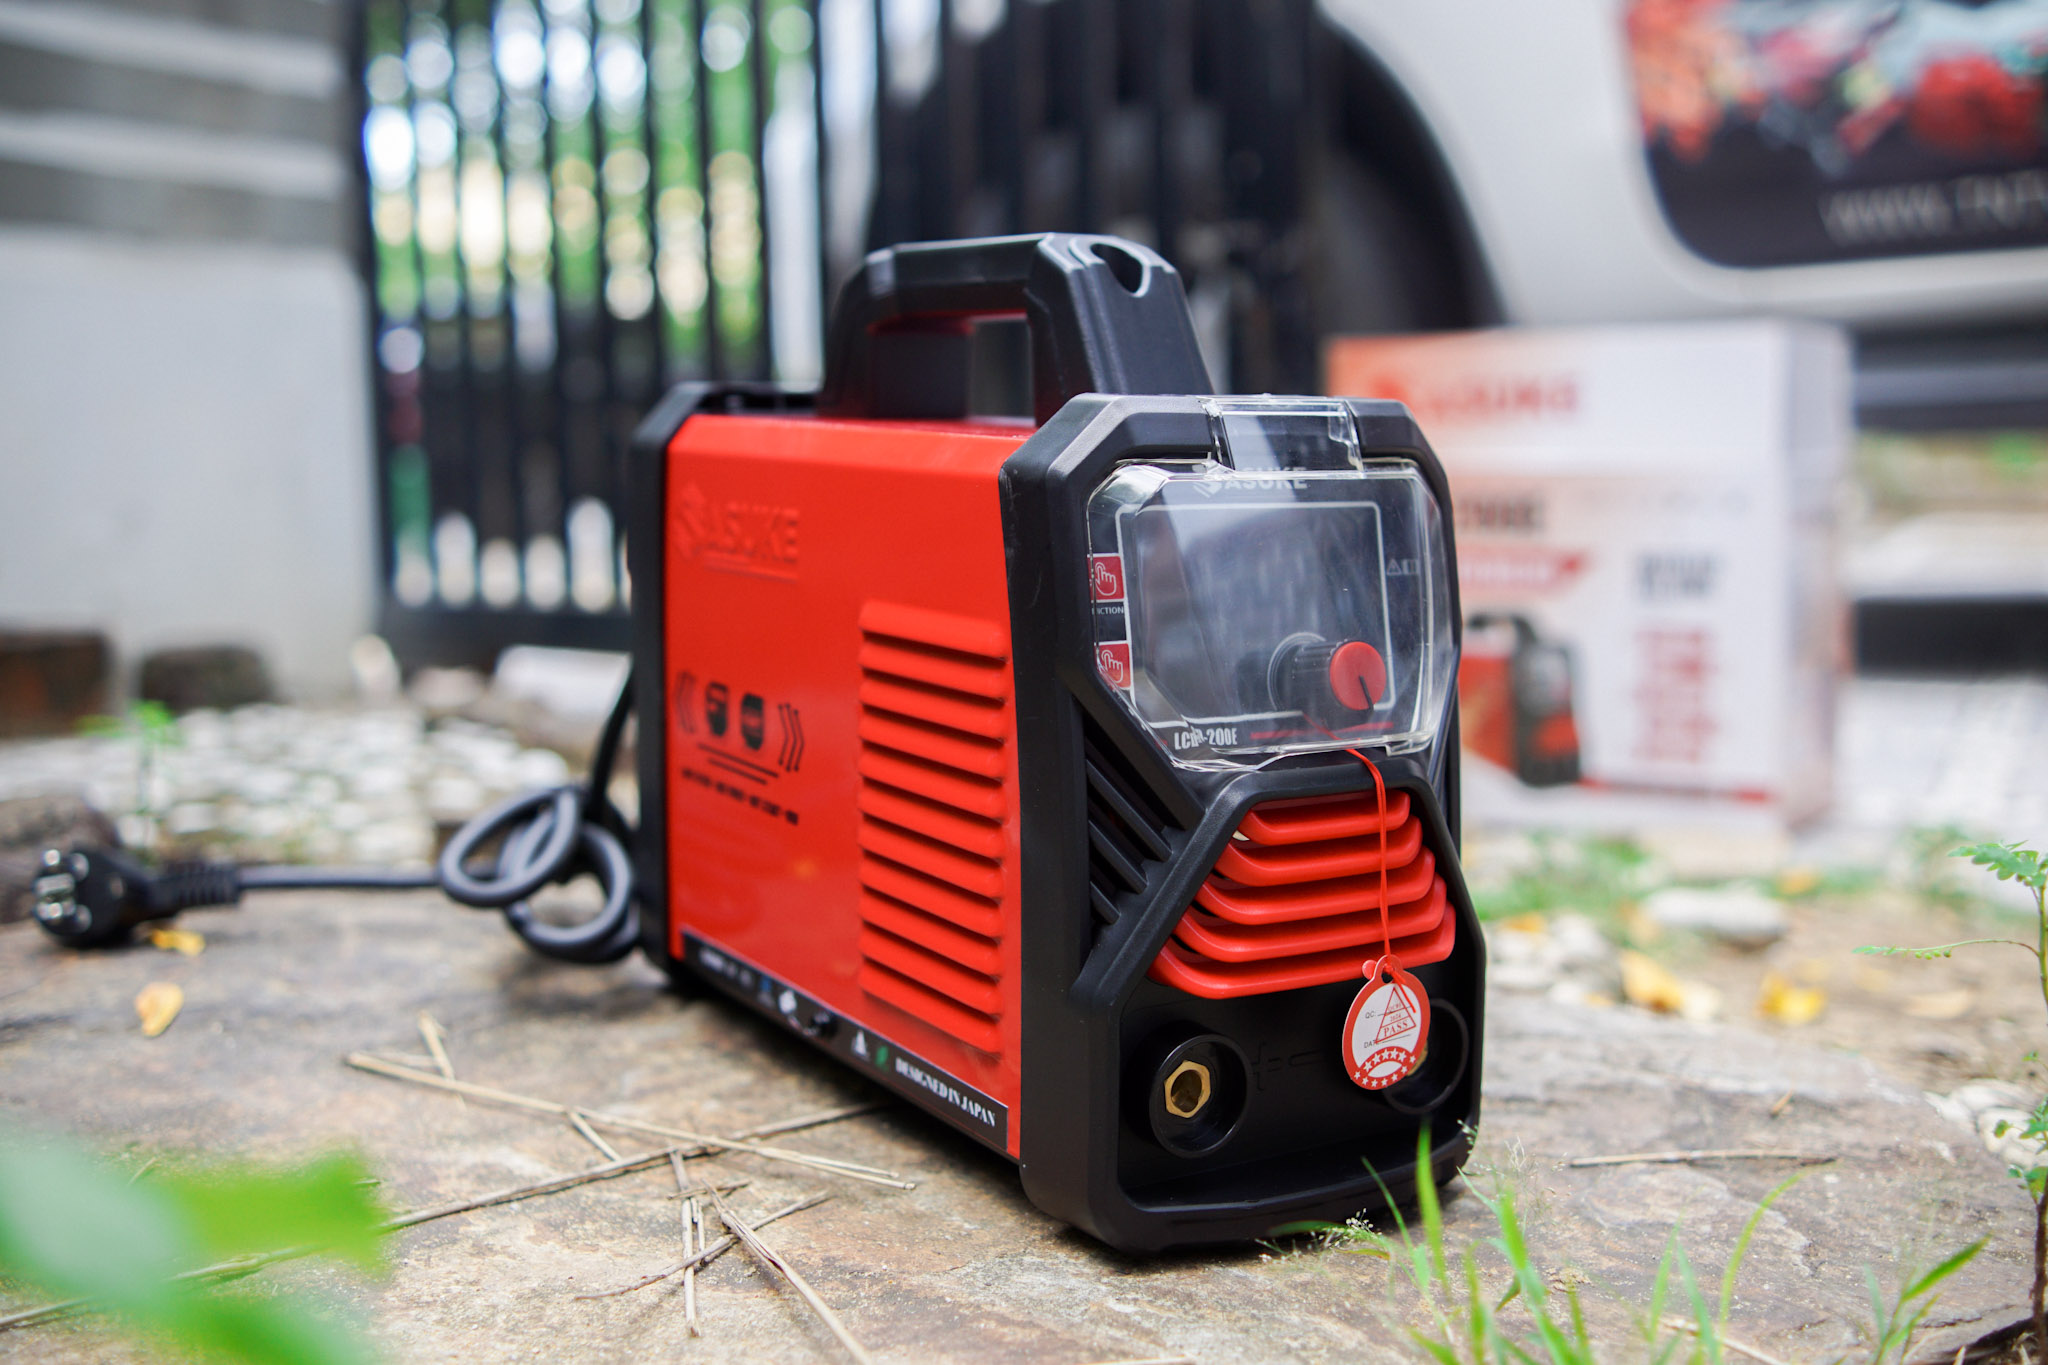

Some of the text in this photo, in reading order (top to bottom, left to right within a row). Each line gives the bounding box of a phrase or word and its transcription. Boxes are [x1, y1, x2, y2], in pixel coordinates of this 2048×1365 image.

[1384, 1021, 1409, 1037] PASS
[895, 1057, 996, 1127] DESIGNED IN JAPAN
